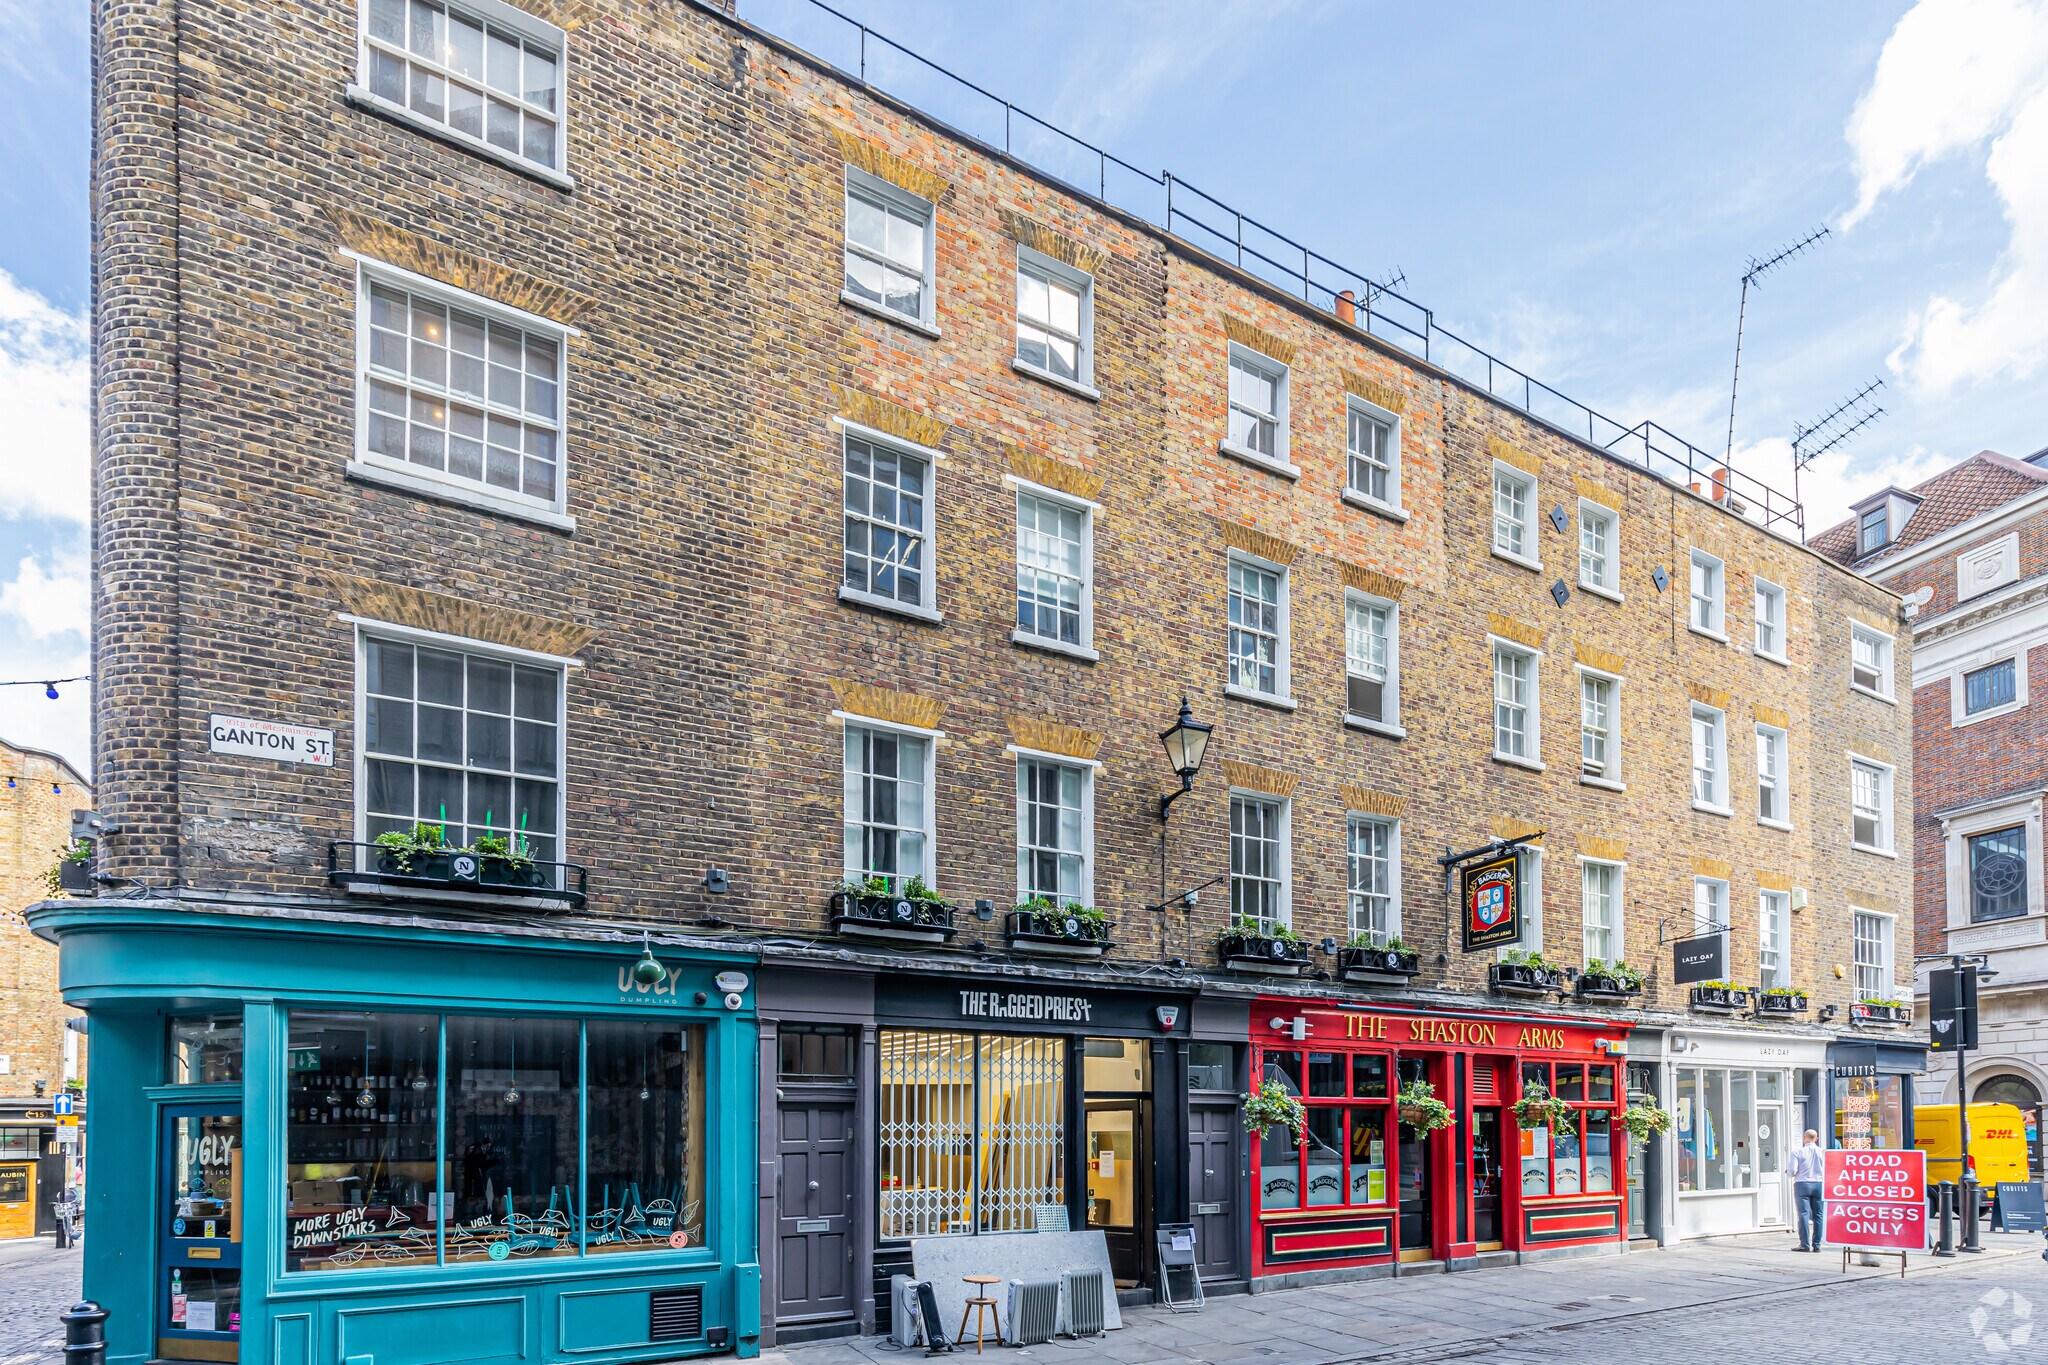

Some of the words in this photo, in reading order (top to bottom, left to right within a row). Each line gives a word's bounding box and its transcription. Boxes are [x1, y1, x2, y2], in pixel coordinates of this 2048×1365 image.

[226, 719, 246, 729] City
[250, 721, 259, 729] of
[262, 724, 319, 737] Westminster
[213, 726, 295, 751] GANTON
[305, 738, 330, 756] ST.
[1478, 871, 1503, 886] BADGER
[1682, 955, 1698, 963] LAZY
[1699, 953, 1714, 961] OAF
[620, 996, 677, 1005] DUMPLING
[959, 990, 988, 1016] THE
[1044, 997, 1092, 1022] PRIEST
[1343, 1014, 1388, 1040] THE
[1410, 1018, 1497, 1046] SHASTON
[1517, 1027, 1565, 1050] ARMS
[1778, 1048, 1790, 1056] OAF
[1835, 1065, 1875, 1077] CUBITTS
[1986, 1129, 2016, 1139] DHL
[188, 1134, 235, 1167] UGLY
[1845, 1154, 1902, 1167] ROAD
[1314, 1177, 1335, 1187] BADGER
[1838, 1169, 1909, 1182] AHEAD
[1270, 1180, 1291, 1190] BADGER
[1832, 1184, 1915, 1198] CLOSED
[1832, 1204, 1919, 1221] ACCESS
[294, 1213, 331, 1235] MORE
[336, 1206, 368, 1226] UGLY
[470, 1213, 493, 1229] UGLY
[652, 1217, 673, 1227] UGLY
[1846, 1220, 1904, 1236] ONLY
[293, 1219, 377, 1249] DOWNSTAIRS
[595, 1230, 615, 1246] UGLY
